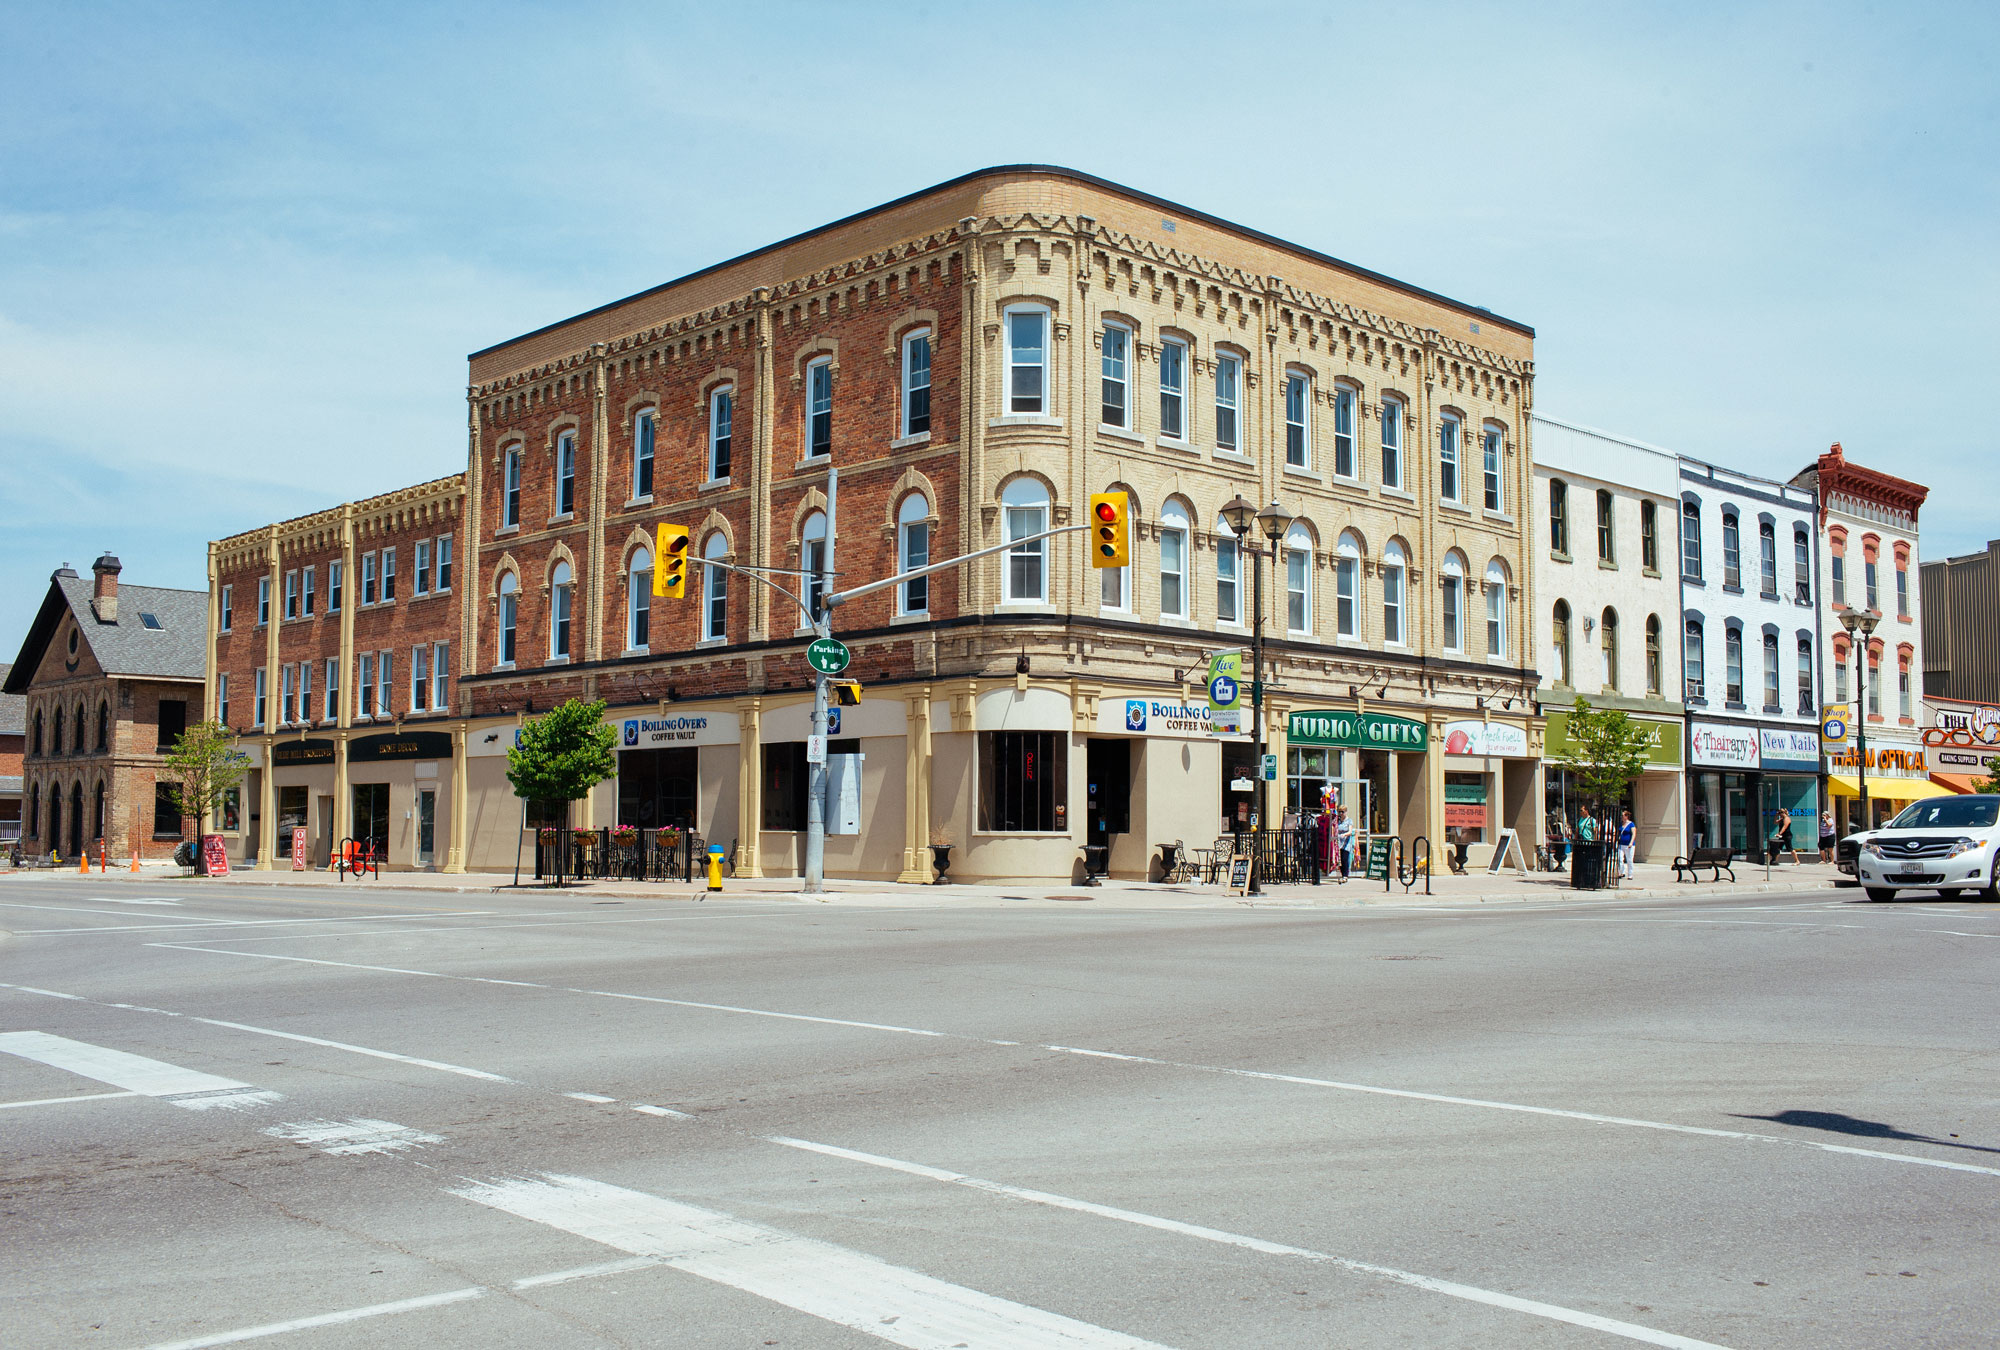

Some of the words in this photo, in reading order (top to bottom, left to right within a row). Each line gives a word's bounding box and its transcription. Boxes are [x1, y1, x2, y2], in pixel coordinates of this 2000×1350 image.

[813, 645, 844, 656] Parking
[1216, 659, 1235, 673] Live
[1151, 702, 1200, 719] BOILING
[1825, 709, 1846, 718] Shop
[641, 719, 677, 732] BOILING
[677, 717, 707, 730] OVER'S
[1166, 719, 1198, 731] COFFEE
[1944, 715, 1968, 729] BULK
[652, 732, 675, 741] COFFEE
[676, 731, 696, 740] VAULT
[1292, 716, 1351, 739] FURIO
[1369, 722, 1422, 744] GIFTS
[379, 743, 397, 753] HOME
[398, 742, 417, 752] DECOR
[1703, 731, 1748, 761] Thairapy
[1763, 732, 1785, 749] New
[1790, 734, 1817, 752] Nails
[1880, 749, 1928, 771] OPTICAL
[1942, 754, 1957, 762] BAKING
[1958, 755, 1976, 764] SUPPLIES
